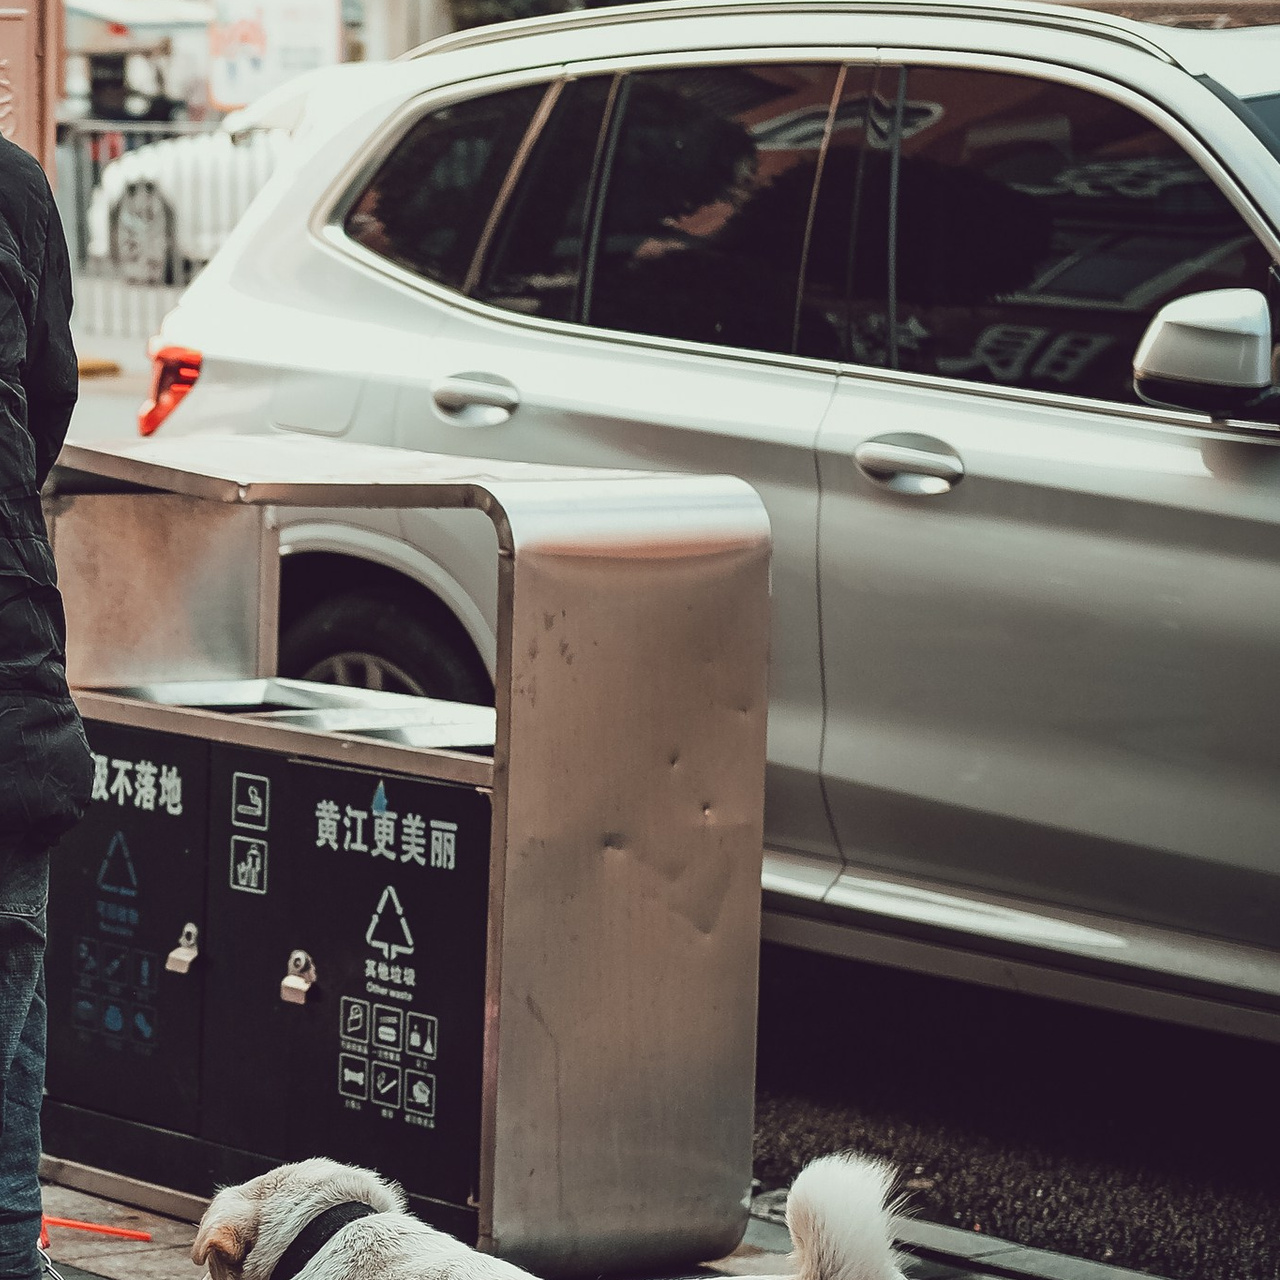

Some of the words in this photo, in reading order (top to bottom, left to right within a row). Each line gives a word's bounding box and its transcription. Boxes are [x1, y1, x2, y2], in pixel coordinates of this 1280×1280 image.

[315, 799, 458, 870] 黄江更美丽
